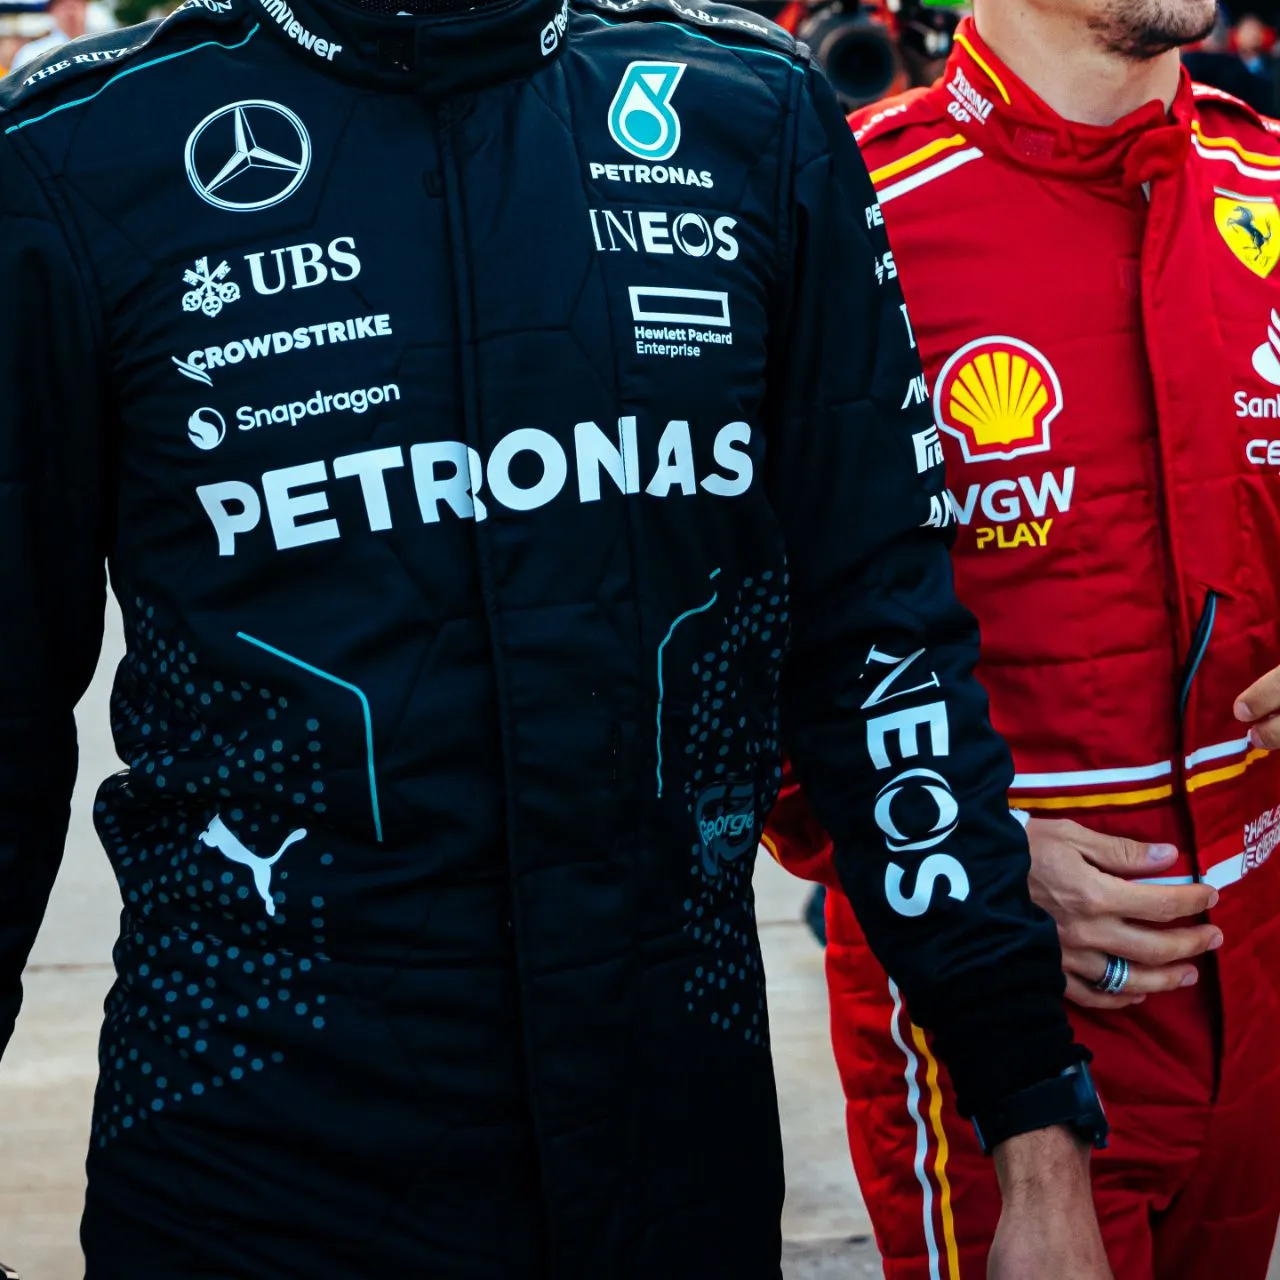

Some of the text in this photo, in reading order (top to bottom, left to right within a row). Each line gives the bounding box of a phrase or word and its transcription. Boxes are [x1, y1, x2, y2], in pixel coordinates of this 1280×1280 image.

[23, 58, 71, 87] THE
[952, 66, 994, 119] PERONI
[589, 162, 714, 189] PETRONAS
[588, 208, 739, 261] INEOS
[245, 236, 362, 295] UBS
[187, 313, 393, 373] CROWDSTRIKE
[634, 326, 733, 345] Hewlett Packard
[635, 341, 701, 358] Enterprise
[235, 383, 401, 432] Snapdragon
[195, 416, 755, 556] PETRONAS
[947, 465, 1076, 526] VGW
[976, 519, 1054, 550] PLAY
[859, 644, 970, 918] NEOS
